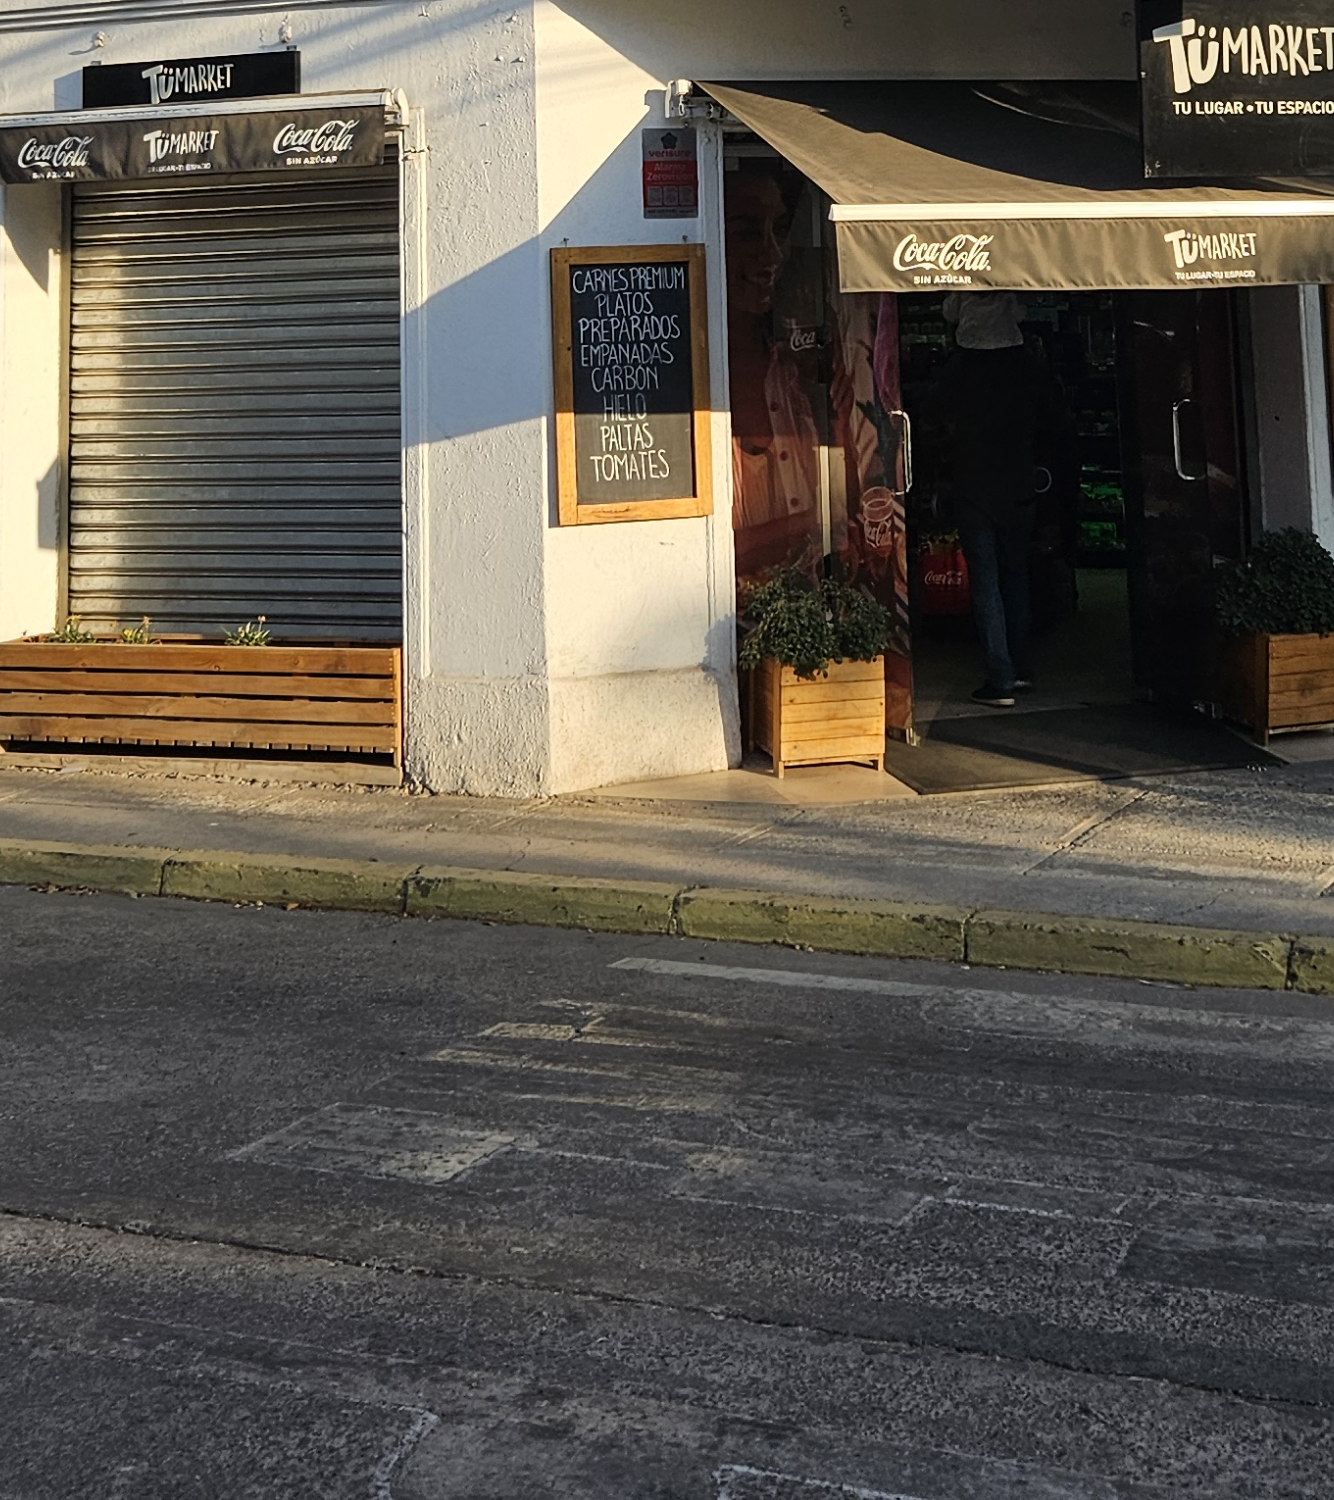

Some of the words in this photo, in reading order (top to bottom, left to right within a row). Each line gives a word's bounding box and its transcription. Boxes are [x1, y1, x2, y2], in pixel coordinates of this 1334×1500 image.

[1172, 101, 1191, 115] TU
[1195, 101, 1244, 115] LUGAR
[273, 118, 362, 155] Coca-Cola
[17, 135, 96, 169] Coca-Cola
[286, 156, 302, 167] SIN
[303, 154, 338, 165] AZÚCAR
[893, 233, 995, 272] Coca-Cola
[572, 268, 629, 294] CARNES
[629, 266, 685, 291] PREMIUM
[913, 275, 932, 284] SIN
[594, 292, 654, 318] PLATOS
[578, 315, 681, 344] PREPARADOS
[581, 342, 674, 367] EMPANADAS
[602, 392, 648, 423] HIELO
[600, 423, 654, 452] PALTAS
[589, 449, 670, 482] TOMATES
